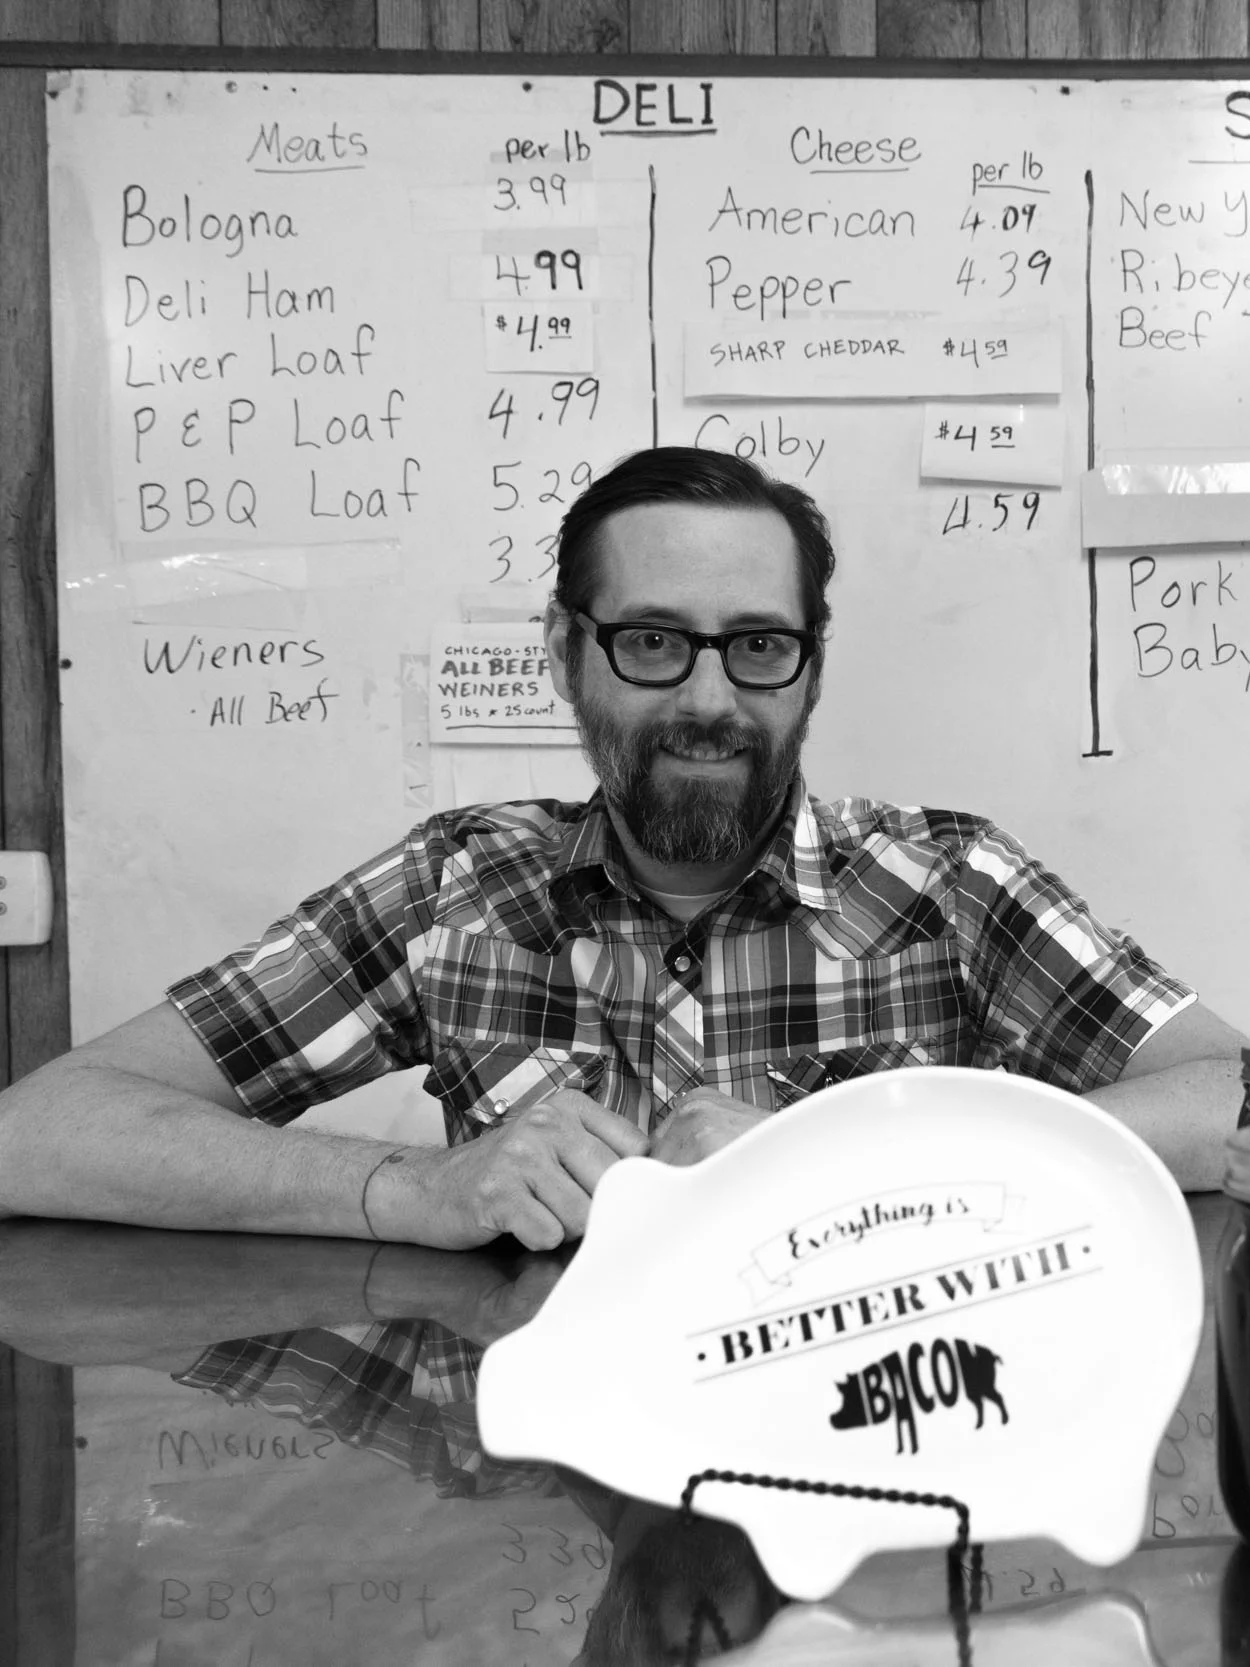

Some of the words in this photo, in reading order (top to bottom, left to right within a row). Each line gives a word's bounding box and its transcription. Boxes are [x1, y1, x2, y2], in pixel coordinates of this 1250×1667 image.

[593, 79, 714, 126] DELI
[246, 122, 370, 164] Meats
[504, 136, 548, 163] per
[564, 130, 592, 162] lb
[790, 126, 922, 165] Cheese
[972, 162, 1009, 195] per
[1022, 151, 1044, 180] lb
[121, 184, 299, 258] Bologna
[493, 173, 568, 212] 3.99
[708, 186, 916, 237] American
[960, 203, 1038, 241] 4.09
[1119, 189, 1206, 231] New
[123, 276, 208, 328] Deli
[246, 270, 336, 320] Ham
[496, 249, 584, 297] 4.99
[706, 255, 852, 321] Pepper
[956, 249, 1051, 298] 4.39
[1118, 306, 1213, 351] Beef
[124, 345, 238, 388] Liver
[270, 323, 377, 378] Loaf
[709, 339, 787, 367] SHARP
[804, 338, 906, 360] CHEDDAR
[134, 405, 157, 463] P
[180, 408, 202, 447] &
[229, 398, 256, 454] P
[294, 388, 405, 449] Loaf
[489, 377, 600, 440] 4.99
[694, 413, 825, 477] Colby
[138, 478, 258, 532] BBQ
[309, 456, 421, 518] Loaf
[492, 460, 592, 512] 5.29
[942, 490, 1041, 535] 4.59
[489, 534, 559, 584] 3.3
[1128, 555, 1239, 612] Pork
[143, 634, 326, 675] Wieners
[440, 660, 482, 678] ALL
[488, 657, 549, 677] BEEF
[445, 646, 547, 656] CHICAGO-STY
[210, 695, 243, 726] All
[265, 678, 341, 725] Beef
[438, 681, 539, 698] WEINERS
[441, 703, 451, 719] 5
[460, 704, 479, 718] lbs
[524, 700, 555, 716] count
[788, 1201, 936, 1260] Everything
[946, 1196, 971, 1214] is
[720, 1282, 927, 1365] BETTER
[936, 1240, 1073, 1302] WITH
[862, 1337, 1009, 1455] BACON
